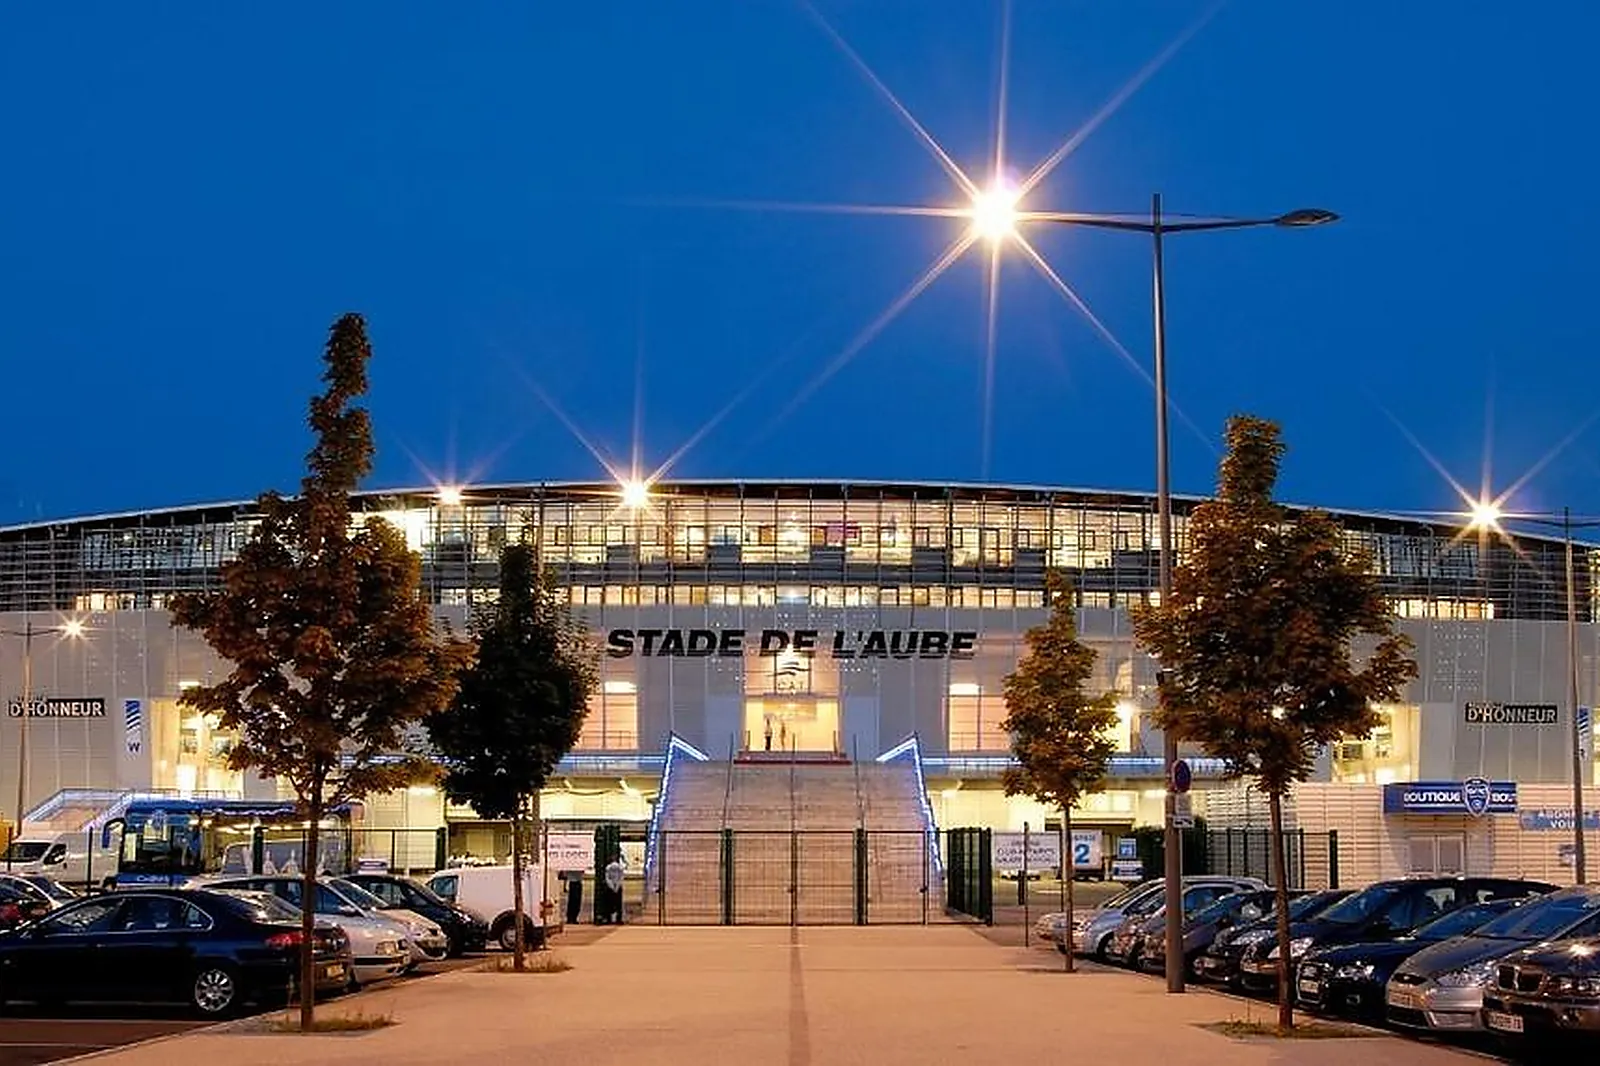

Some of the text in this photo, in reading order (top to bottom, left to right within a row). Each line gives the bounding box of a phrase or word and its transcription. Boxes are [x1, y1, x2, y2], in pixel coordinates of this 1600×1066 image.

[607, 629, 978, 660] STADE DE L'AUBE
[9, 700, 103, 717] D'HONNEUR
[1467, 706, 1557, 722] D'HONNEUR
[1074, 843, 1090, 864] 2
